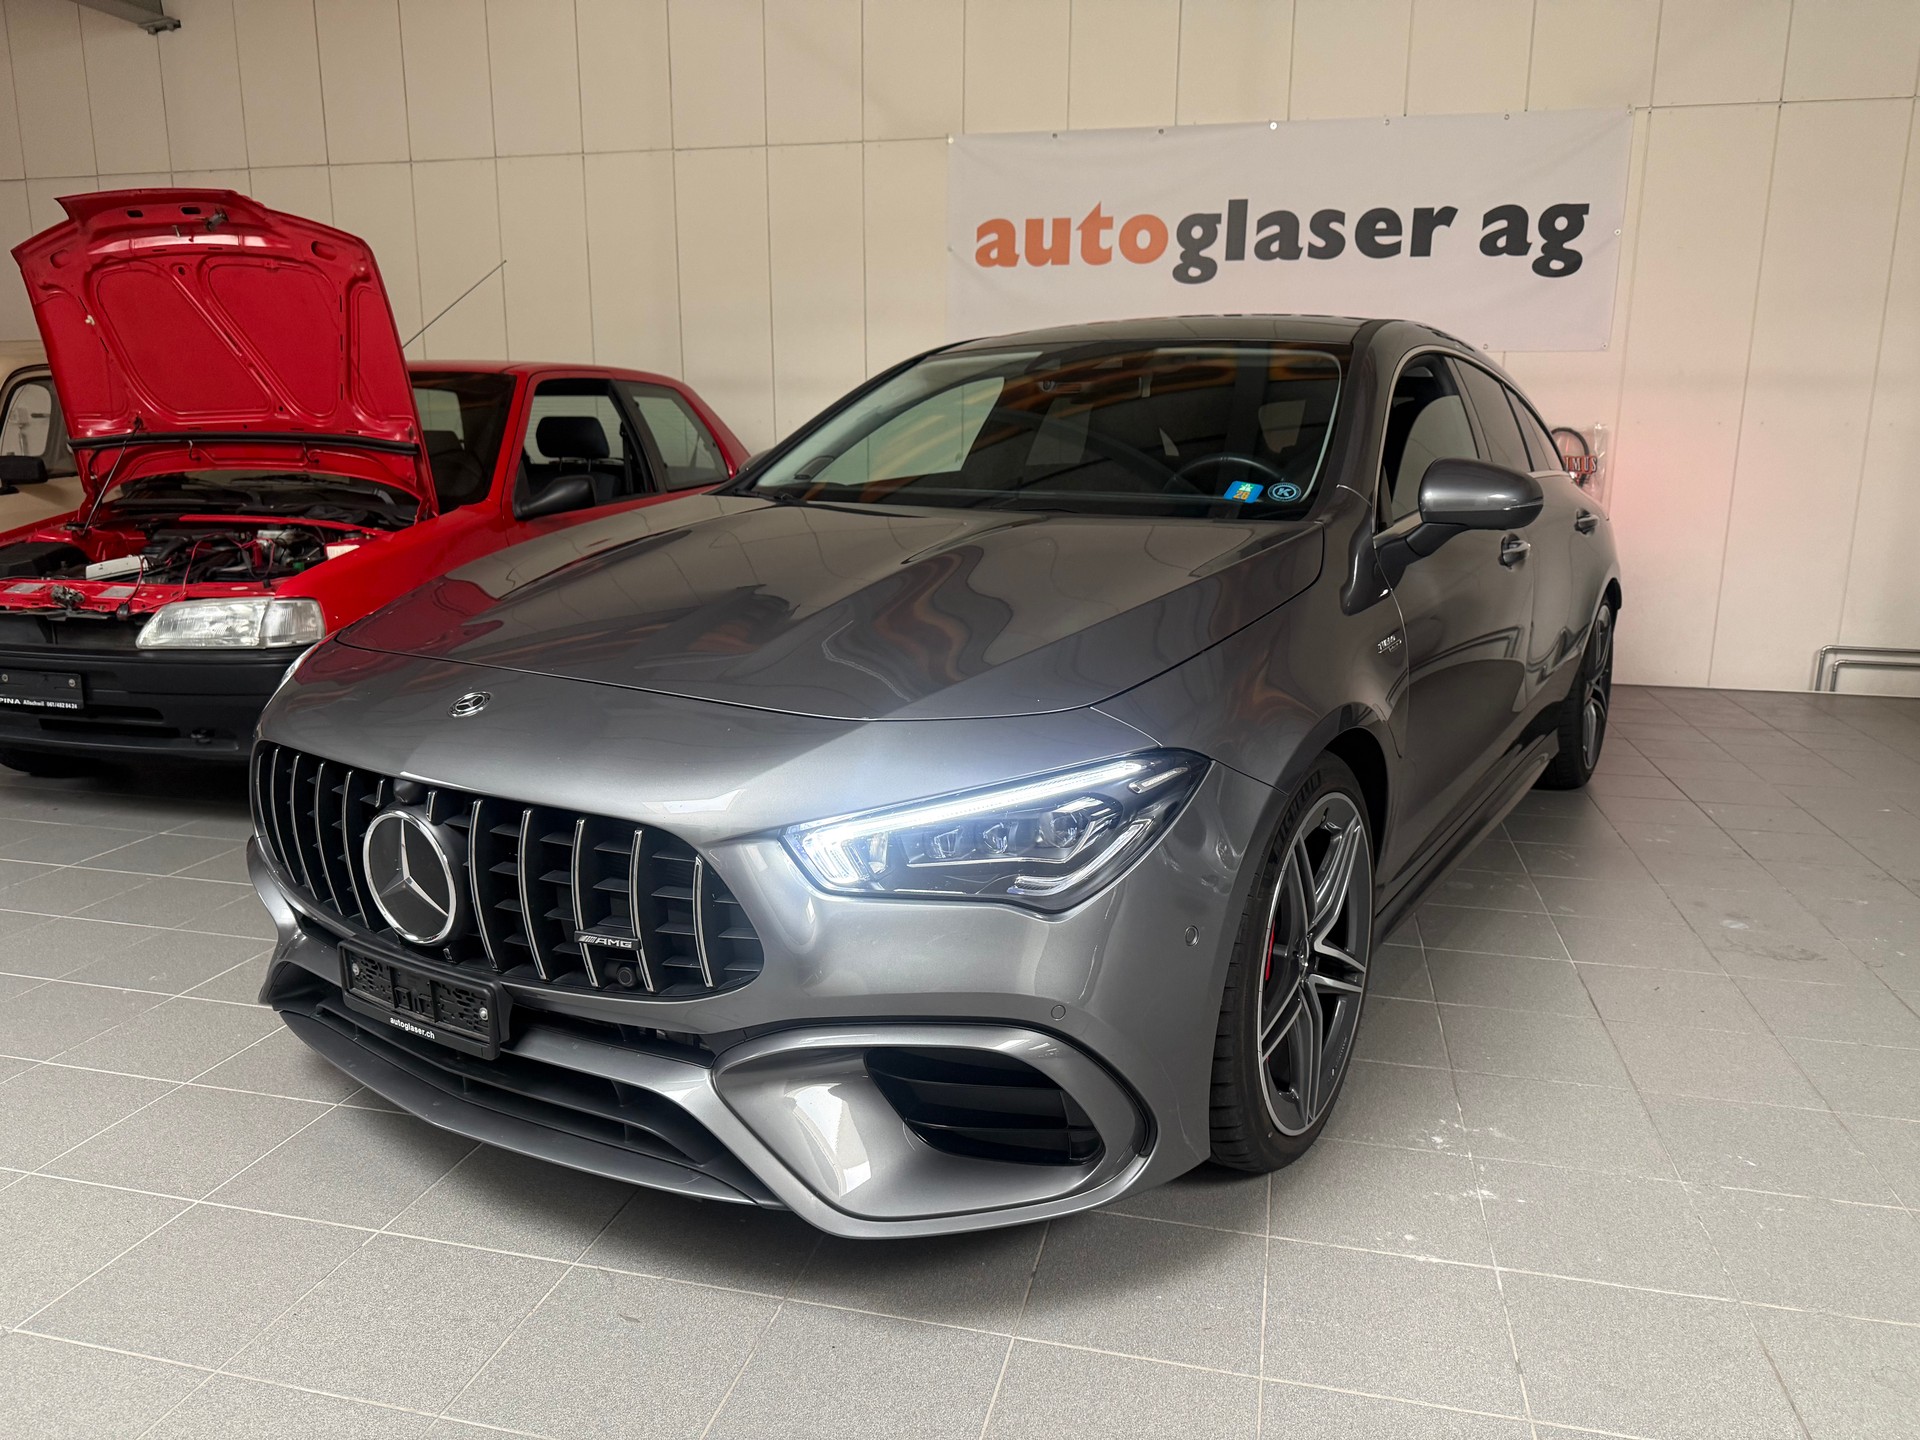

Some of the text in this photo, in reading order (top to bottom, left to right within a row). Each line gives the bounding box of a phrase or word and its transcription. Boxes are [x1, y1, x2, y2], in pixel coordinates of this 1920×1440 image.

[975, 198, 1590, 285] autoglaser ag
[595, 937, 632, 949] AMG
[389, 1016, 435, 1040] autoglaser.ch
